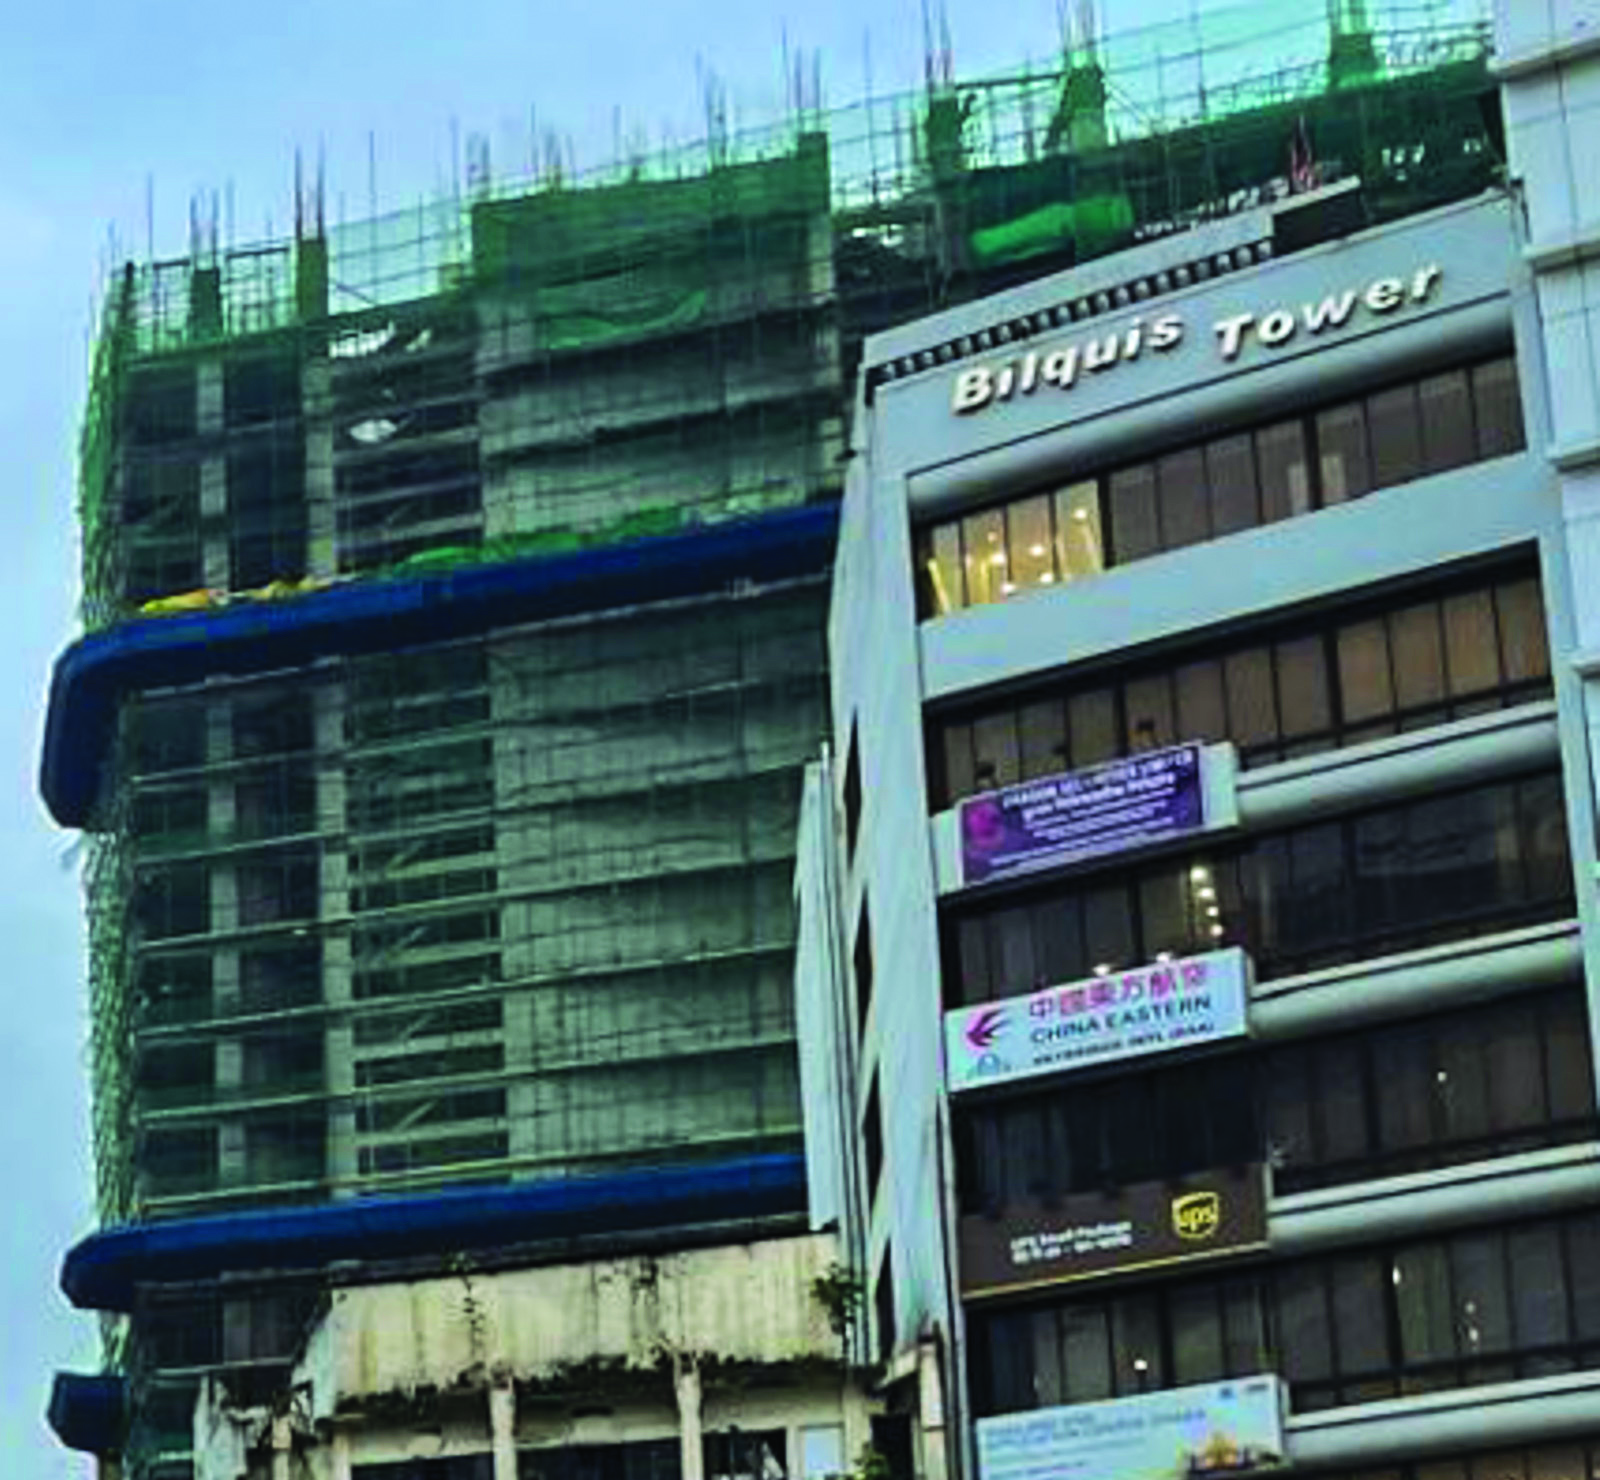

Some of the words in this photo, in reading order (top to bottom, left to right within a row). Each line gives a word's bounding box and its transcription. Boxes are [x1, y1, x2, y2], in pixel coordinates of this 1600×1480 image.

[950, 310, 1184, 416] Bilquis
[1213, 263, 1444, 363] Tower
[1029, 1016, 1101, 1046] CHINA
[1106, 996, 1211, 1031] EASTERN
